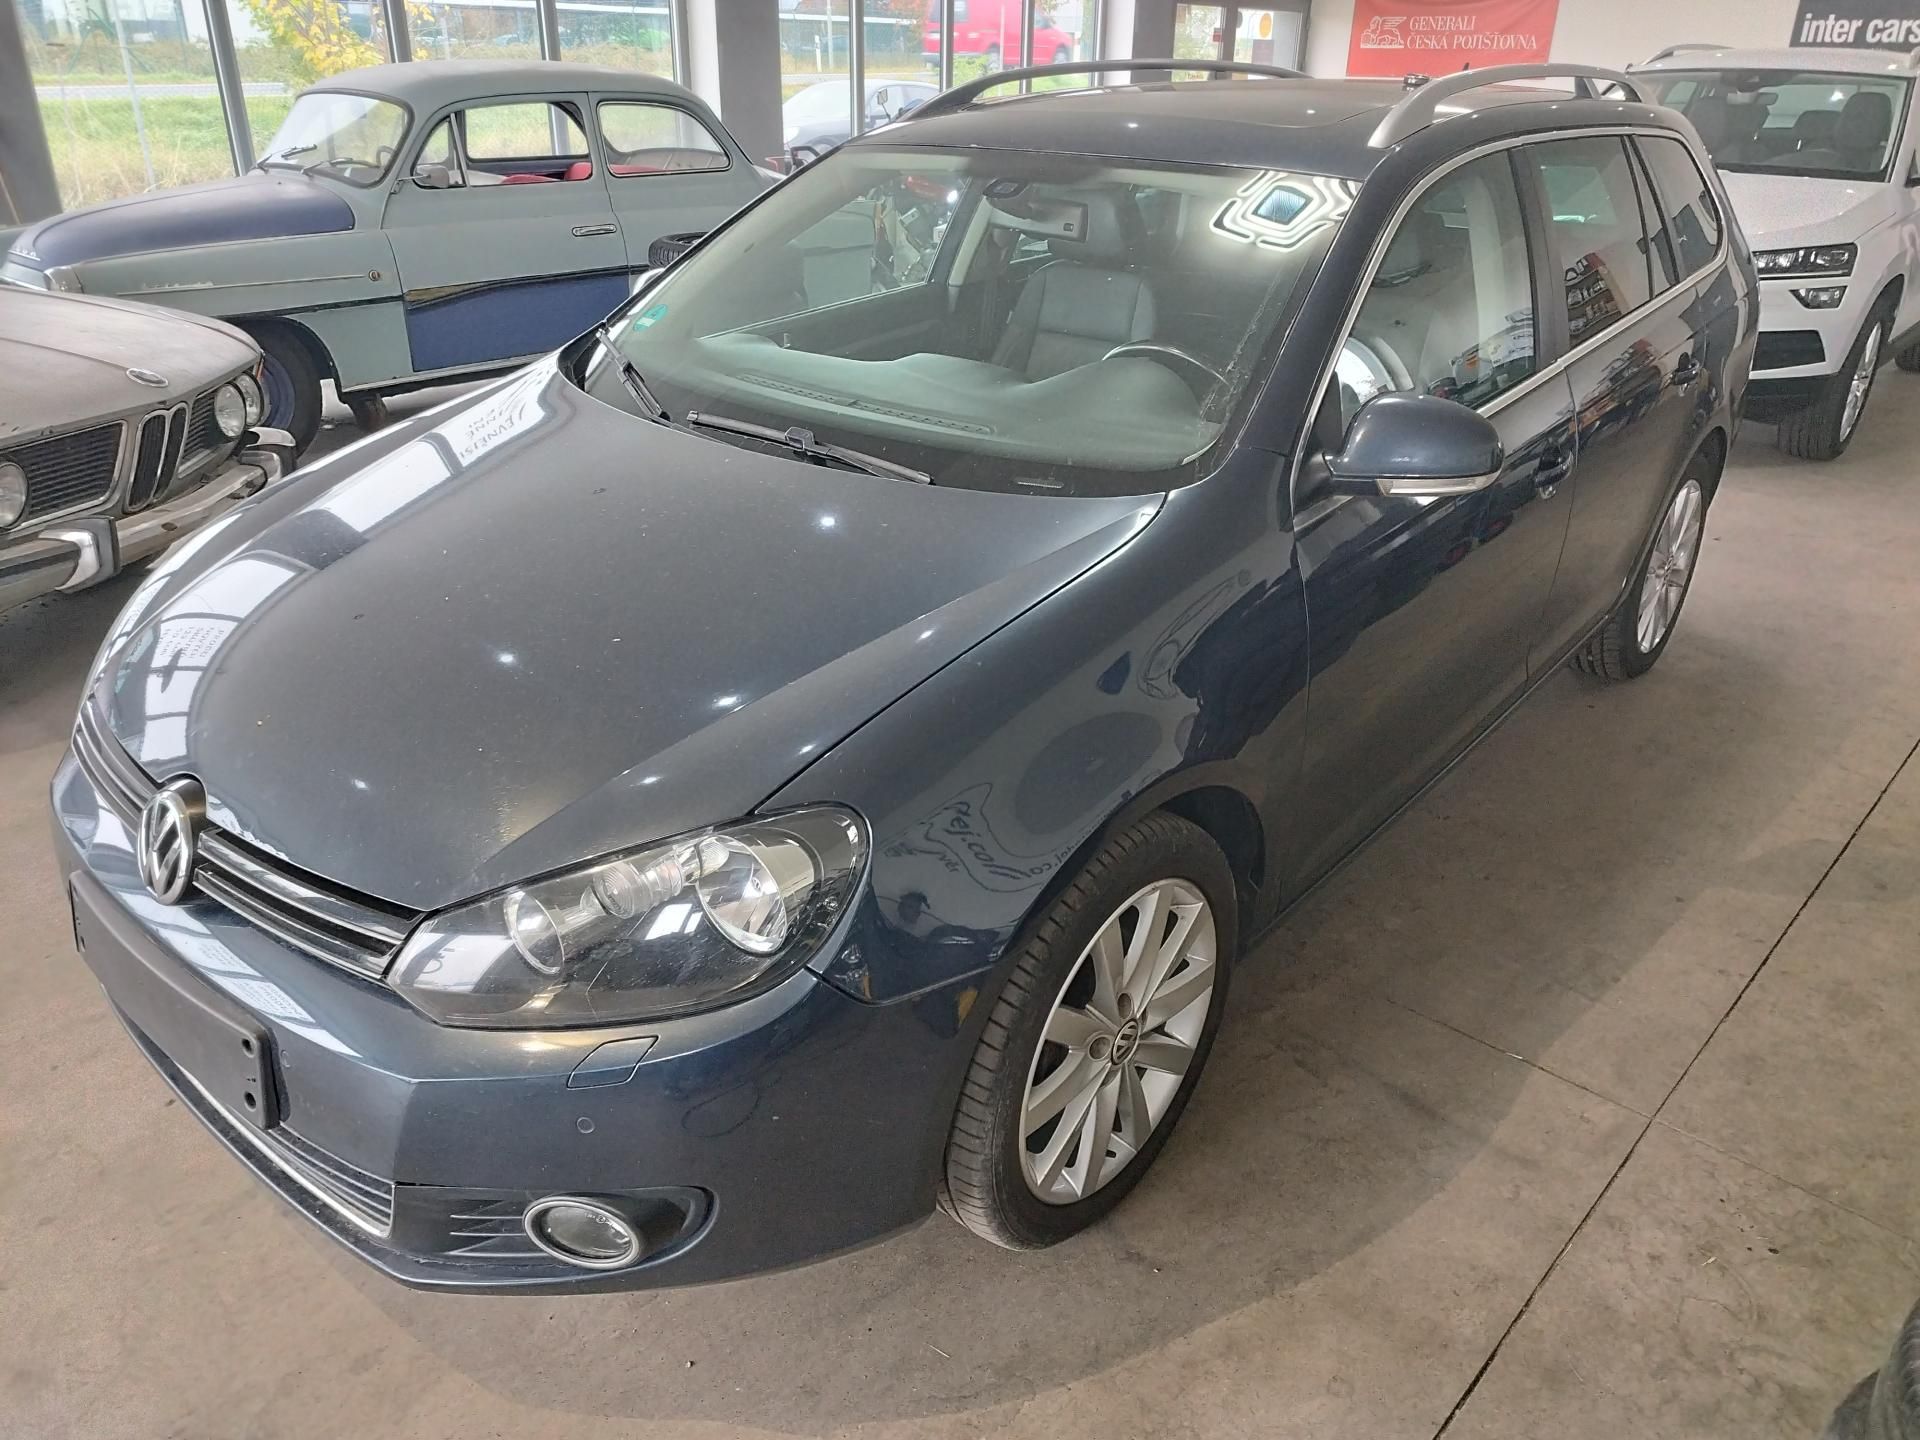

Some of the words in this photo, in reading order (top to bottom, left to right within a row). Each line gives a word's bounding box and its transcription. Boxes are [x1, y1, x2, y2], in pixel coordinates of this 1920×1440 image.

[1409, 15, 1476, 31] GENERALI
[1800, 13, 1863, 43] inter
[1406, 32, 1448, 49] ČESKÁ
[1453, 32, 1537, 49] POJIŠŤOVNA
